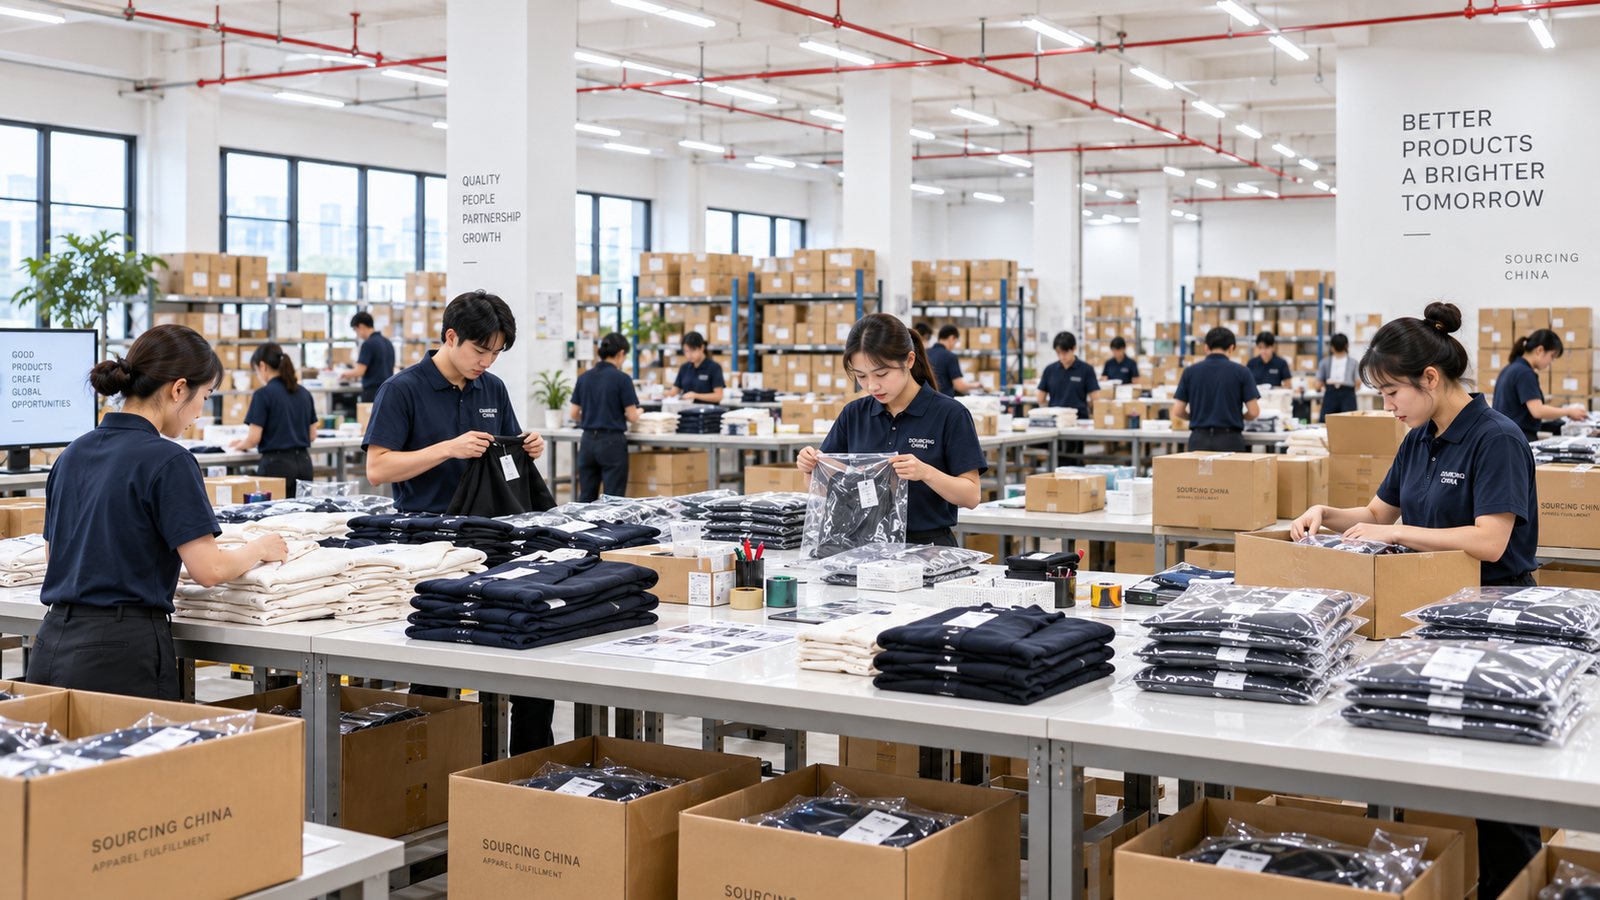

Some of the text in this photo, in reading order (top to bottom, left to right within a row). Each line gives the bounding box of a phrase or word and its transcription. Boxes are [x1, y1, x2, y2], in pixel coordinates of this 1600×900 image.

[1402, 109, 1492, 131] BETTER
[1402, 134, 1533, 158] PRODUCTS
[1402, 161, 1545, 185] A BRIGHTER
[462, 174, 501, 187] QUALITY
[462, 193, 496, 206] PEOPLE
[1401, 189, 1544, 212] TOMORROW
[462, 211, 522, 225] PARTNERSHIP
[462, 231, 501, 244] GROWTH
[1504, 252, 1580, 265] SOURCING
[1504, 269, 1550, 281] CHINA
[11, 350, 35, 359] GOOD
[11, 362, 53, 372] PRODUCTS
[11, 374, 41, 384] CREATE
[11, 387, 42, 397] GLOBAL
[11, 399, 72, 409] OPPORTUNITIES
[1540, 502, 1600, 511] SOURCING CHIN
[91, 806, 233, 854] SOURCING CHINA
[91, 832, 211, 873] APPAREL FULFILLMENT
[482, 838, 581, 868] SOURCING CHINA
[482, 856, 563, 879] APPAREL FULFILLMENT
[724, 884, 798, 900] SOURCI
